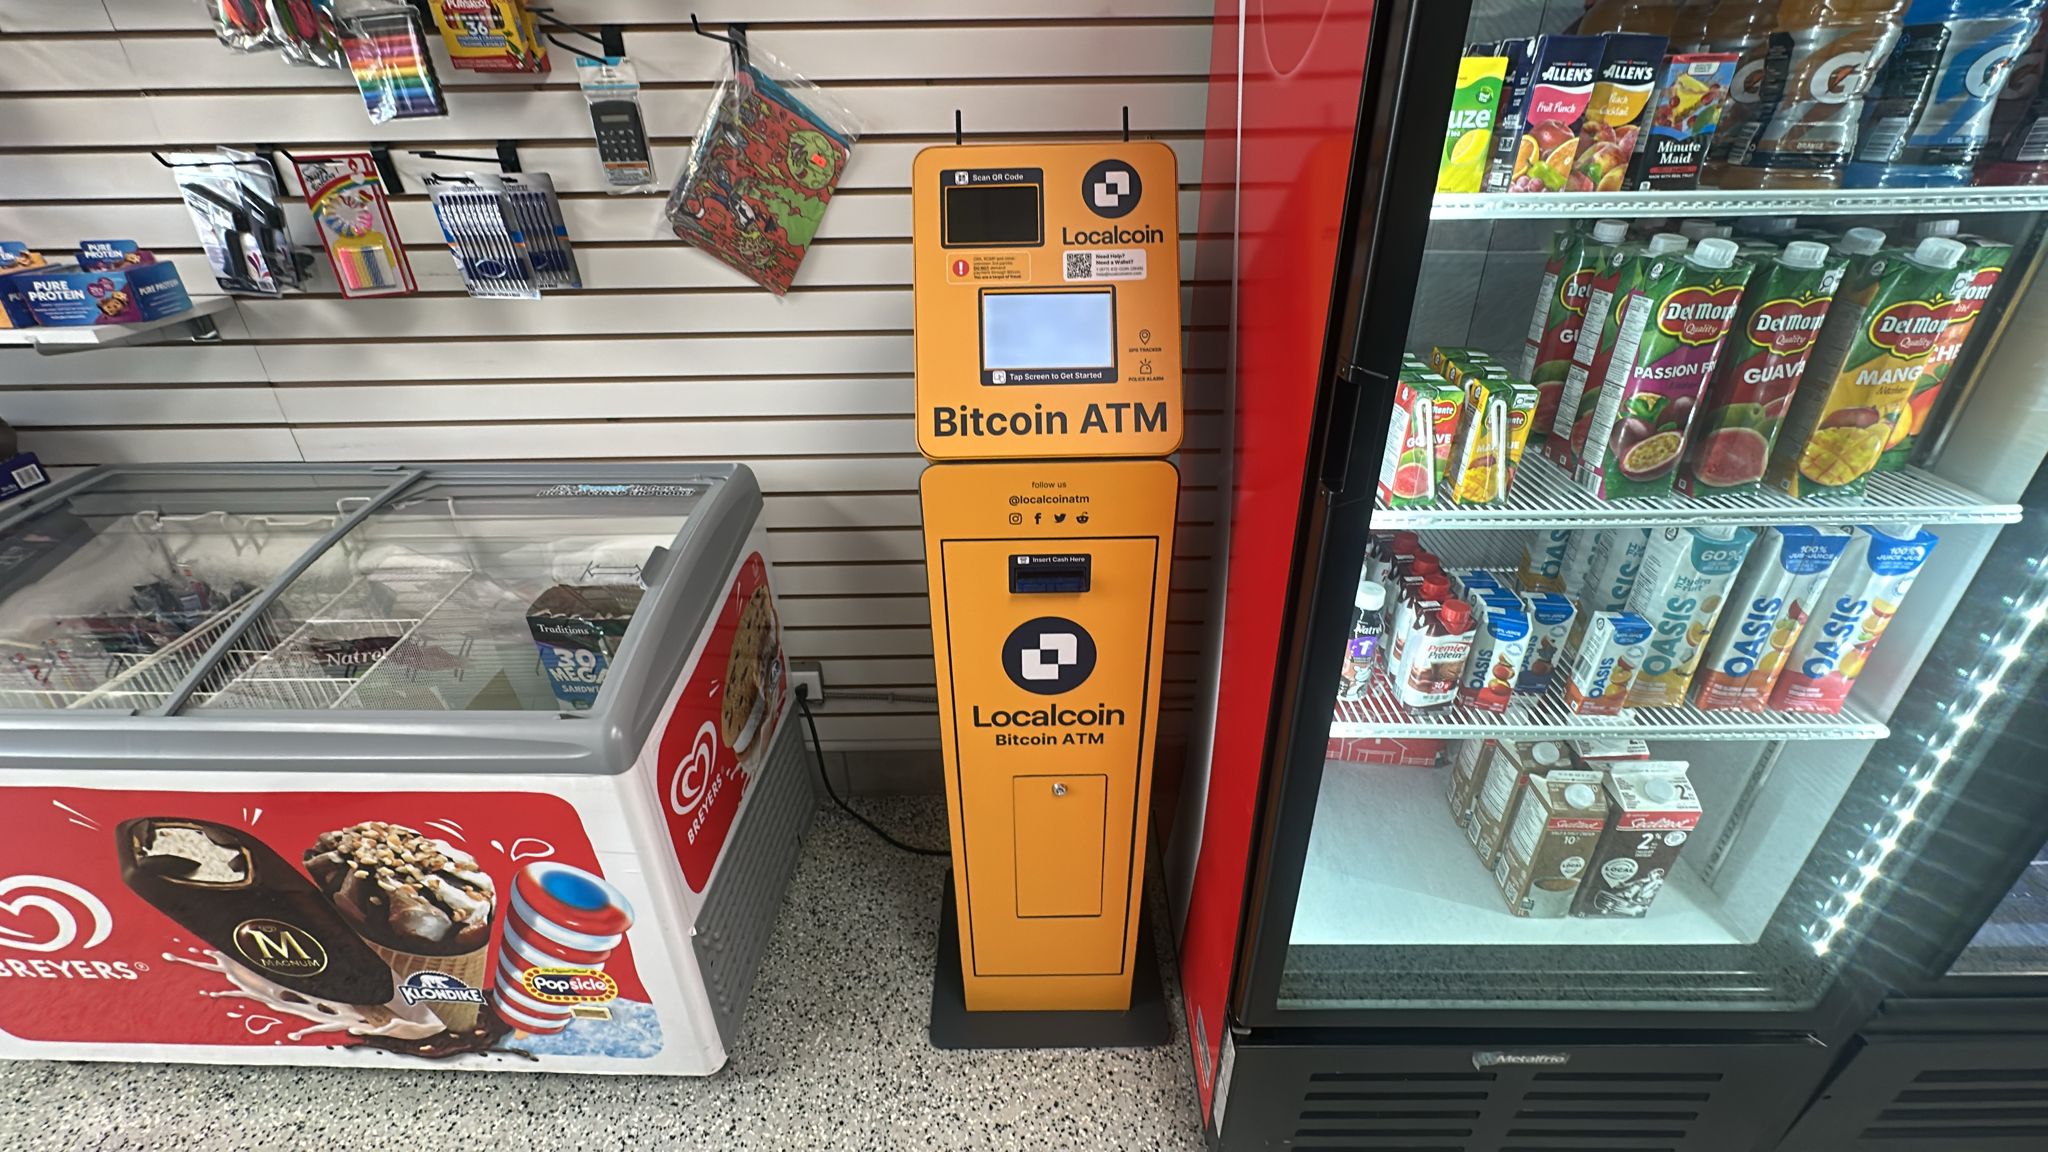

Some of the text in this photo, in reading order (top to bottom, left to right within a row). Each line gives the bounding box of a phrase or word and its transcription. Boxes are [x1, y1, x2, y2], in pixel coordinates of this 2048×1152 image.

[465, 20, 488, 35] 36
[1542, 66, 1593, 81] ALLEN'S
[1603, 65, 1654, 80] ALLEN'S
[1537, 101, 1576, 113] Fruit Punch
[1657, 141, 1701, 153] Minute
[1797, 142, 1824, 150] ORANGE
[1660, 153, 1691, 164] Maid
[972, 173, 1024, 182] Scan QR Code
[1062, 225, 1164, 246] Localcoin
[84, 250, 124, 259] PROTEIN
[87, 244, 112, 252] PURE
[32, 281, 69, 291] PURE
[139, 286, 156, 296] PURE
[28, 289, 85, 302] PROTEIN
[1667, 303, 1695, 320] Del
[1686, 323, 1717, 336] Quality
[1756, 314, 1785, 332] Del
[1880, 316, 1913, 334] Del
[1775, 334, 1807, 347] Quality
[1900, 337, 1933, 349] Quality
[1010, 371, 1102, 382] Tap Screen to Get Started
[1633, 363, 1698, 380] PASSION
[1744, 360, 1807, 385] GUAVA
[933, 402, 1168, 438] Bitcoin ATM
[1032, 481, 1055, 489] follow
[1008, 495, 1090, 506] @localcoinatm
[1701, 550, 1743, 561] 60%
[1800, 545, 1828, 554] 100%
[537, 623, 590, 635] Traditions
[1642, 597, 1696, 677] OASIS
[1724, 597, 1782, 678] OASIS
[1802, 597, 1868, 679] OASIS
[1428, 644, 1467, 653] Premier
[1428, 651, 1462, 660] Protein
[1469, 649, 1494, 690] OASIS
[1589, 657, 1615, 699] OASIS
[973, 703, 1125, 727] Localcoin
[996, 733, 1104, 746] Bitcoin ATM
[686, 776, 723, 845] BREYERS
[1604, 866, 1634, 874] LOCAL
[240, 925, 312, 960] M
[0, 958, 138, 980] BREYERS
[260, 958, 320, 967] MAGNUM
[533, 976, 608, 992] Popsicle
[401, 986, 483, 1003] KLONDIKE
